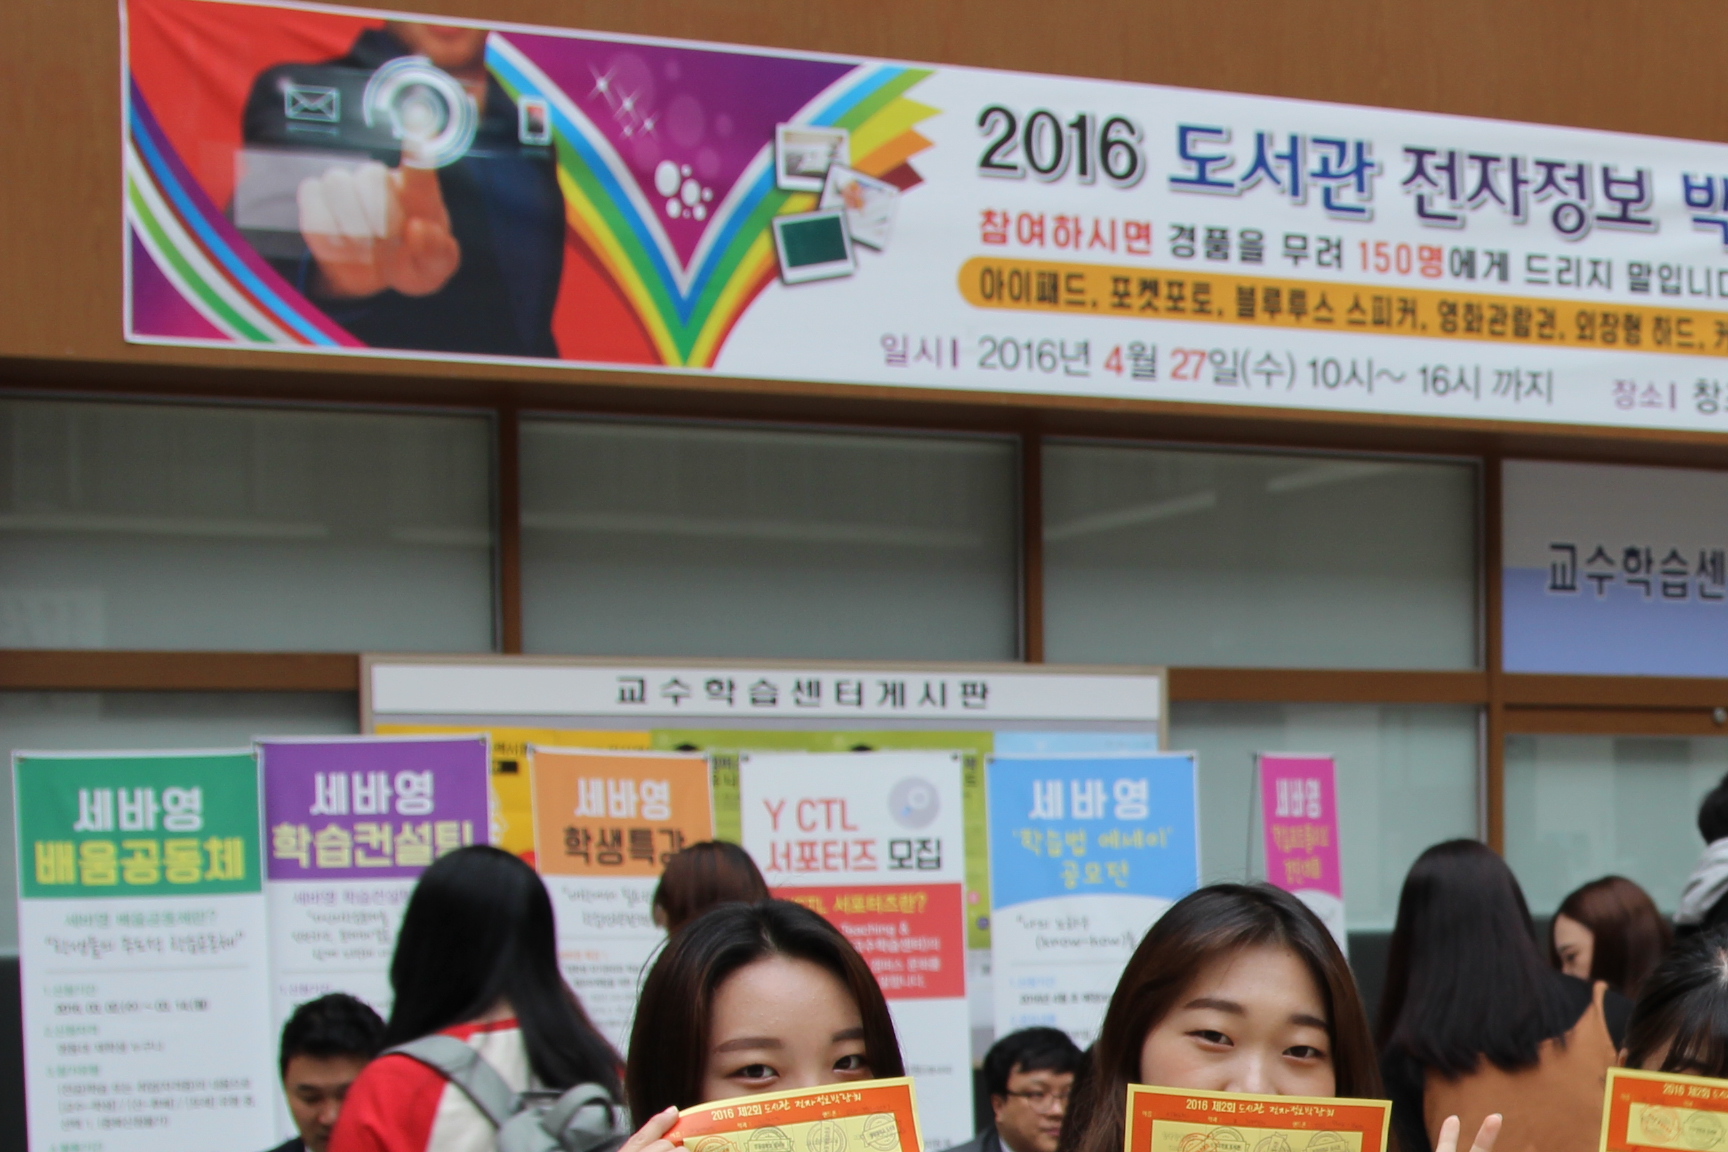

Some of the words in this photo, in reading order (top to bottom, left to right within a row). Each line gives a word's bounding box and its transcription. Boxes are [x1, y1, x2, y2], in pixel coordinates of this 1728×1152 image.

[976, 105, 1143, 186] 2016
[1169, 122, 1378, 220] 도서관
[1401, 147, 1656, 241] 전자정보
[978, 208, 1153, 255] 참여하시면
[1169, 224, 1265, 266] 경품을
[1282, 233, 1343, 271] 무려
[1358, 240, 1510, 283] 150명에게
[1525, 252, 1612, 292] 드리지
[1236, 284, 1333, 323] 블루투스
[1576, 310, 1642, 346] 외장형
[977, 336, 1091, 375] 2016년
[1105, 341, 1158, 381] 4월
[1170, 346, 1296, 391] 27일(수)
[1419, 362, 1481, 400] 16시
[1492, 368, 1553, 405] 까지
[616, 675, 989, 710] 교수학습센터게시판
[73, 785, 206, 833] 세바영
[309, 769, 436, 817] 세바영
[574, 777, 672, 821] 세바영
[796, 798, 859, 832] CTL
[1028, 777, 1151, 821] 세바영
[33, 835, 246, 887] 배움공동체
[766, 838, 879, 872] 서포터즈
[887, 837, 942, 870] 모집
[711, 1108, 736, 1121] 2016
[737, 1104, 763, 1117] 제2회
[1186, 1098, 1209, 1111] 2016
[1211, 1100, 1236, 1114] 제2회
